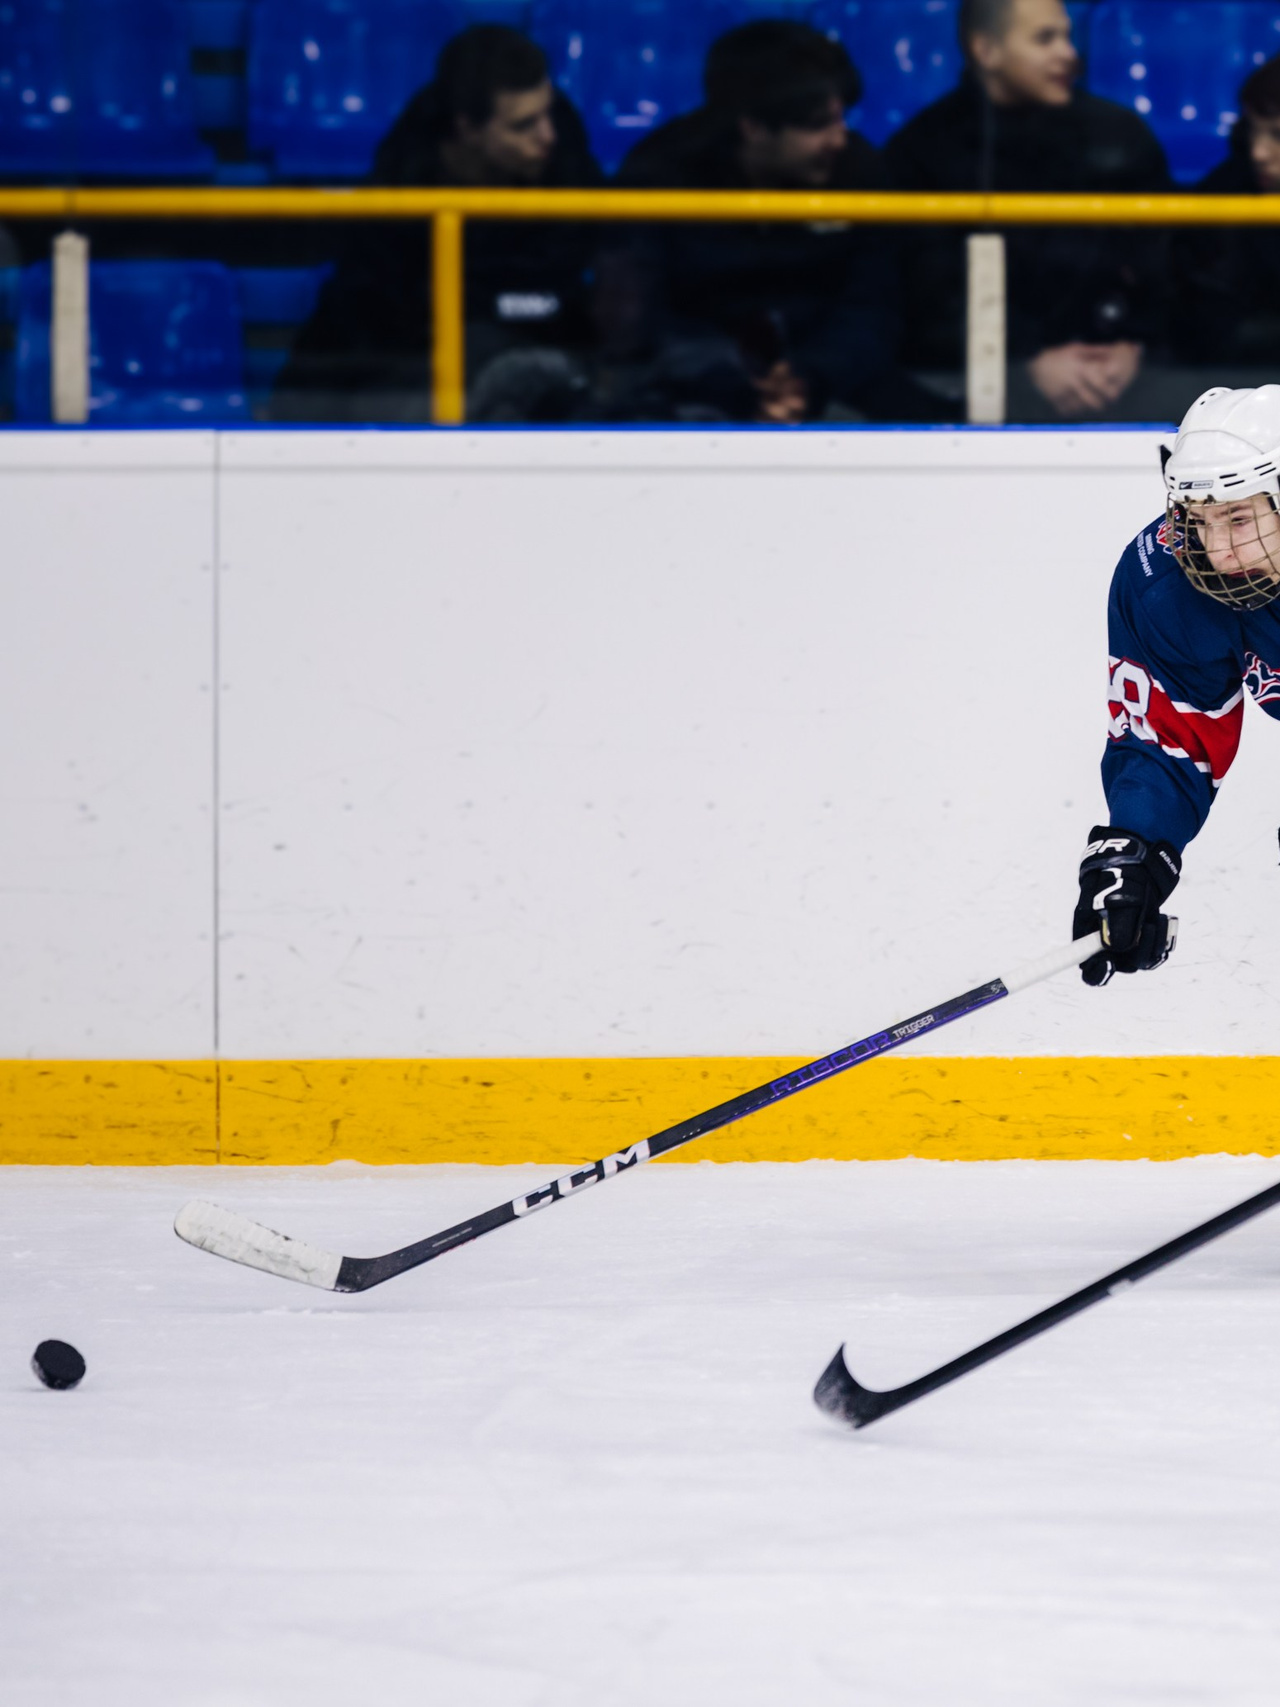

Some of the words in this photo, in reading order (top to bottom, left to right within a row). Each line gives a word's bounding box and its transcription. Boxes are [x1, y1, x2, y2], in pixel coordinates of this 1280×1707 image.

[512, 1138, 650, 1218] CCM
[769, 1031, 892, 1097] RIBCOR
[892, 1014, 935, 1039] TRIGGER
